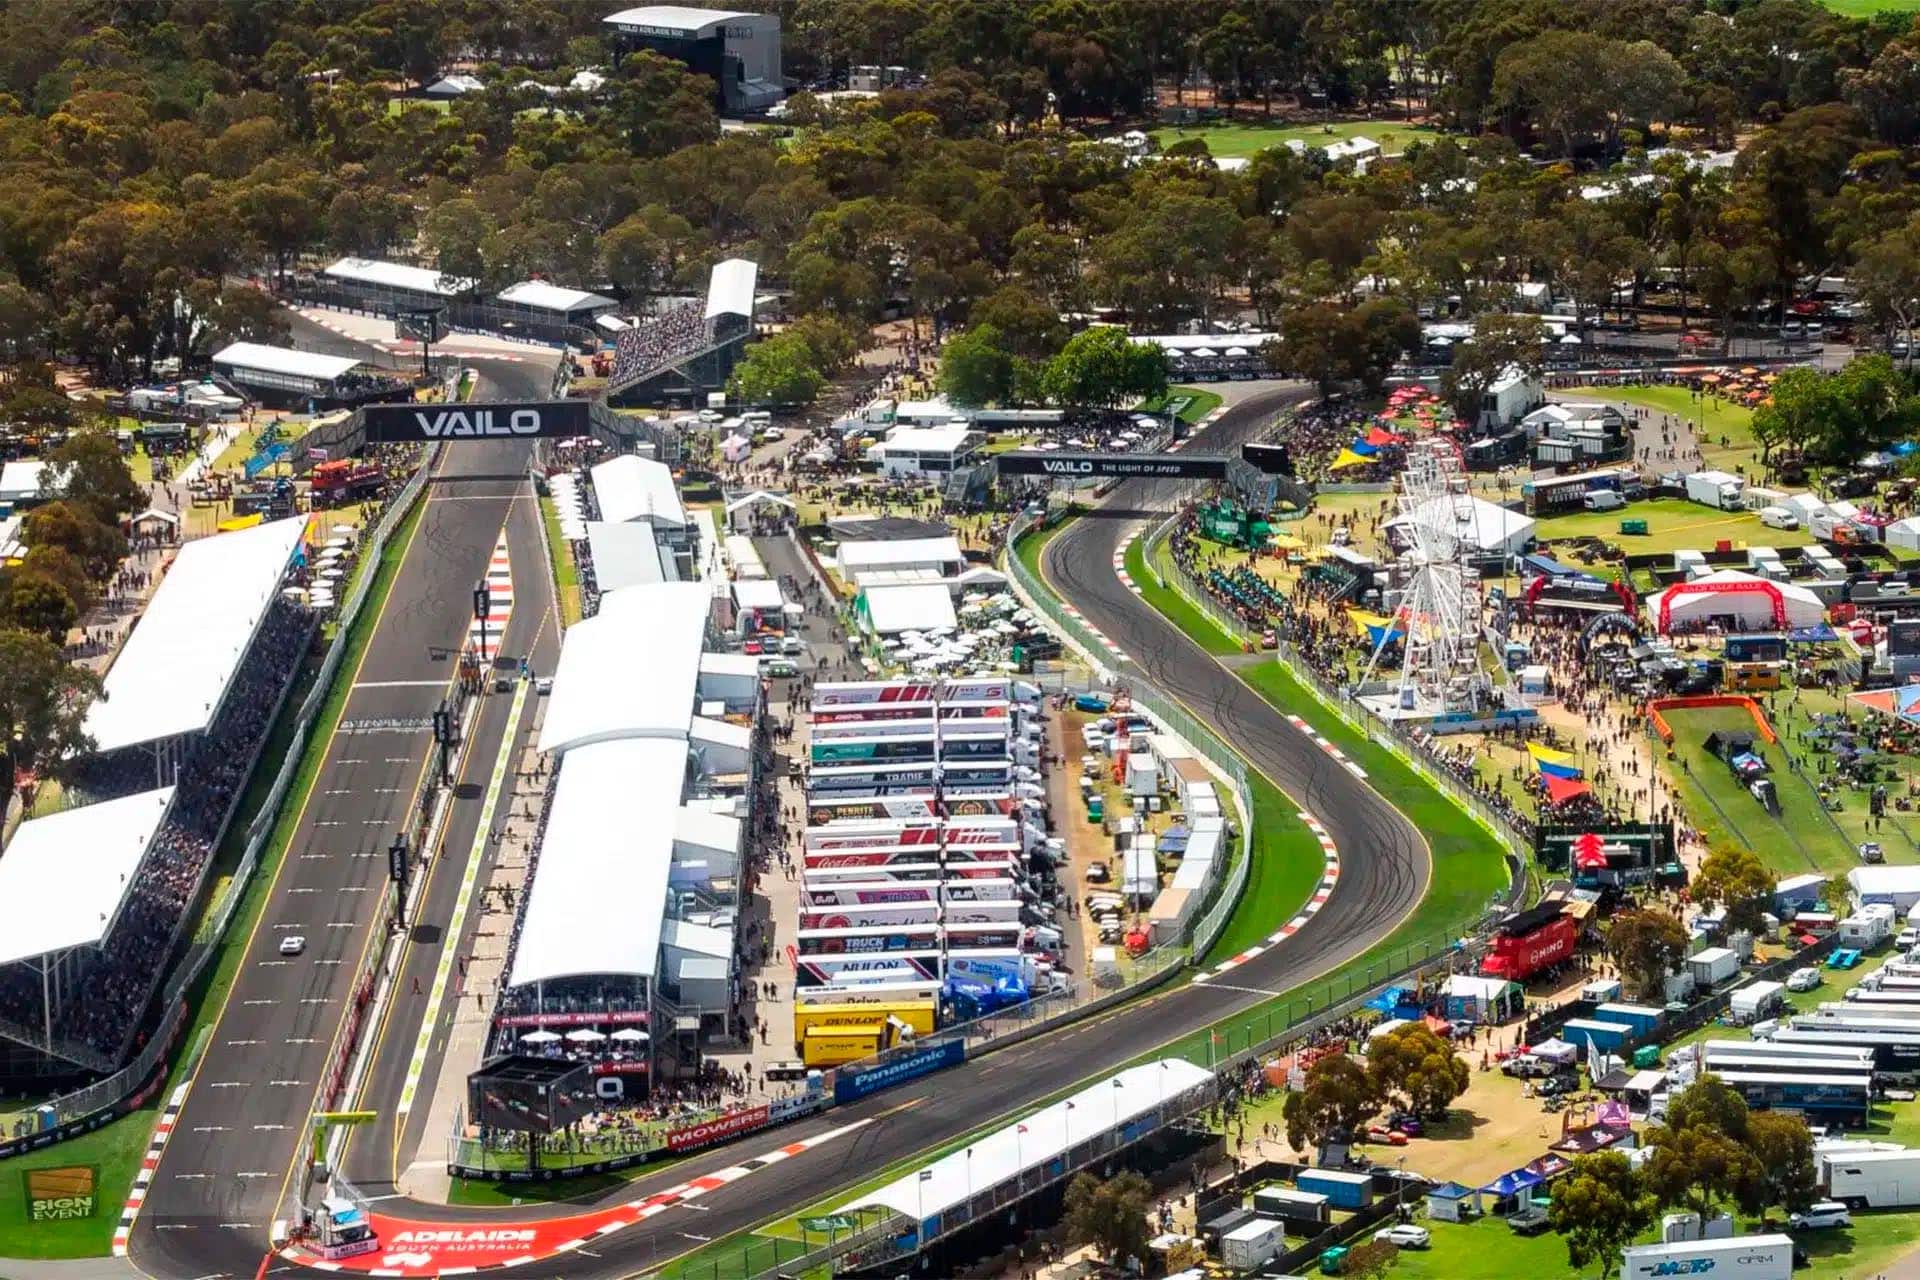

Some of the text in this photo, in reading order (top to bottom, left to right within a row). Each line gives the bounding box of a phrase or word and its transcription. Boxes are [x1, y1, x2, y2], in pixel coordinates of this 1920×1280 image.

[415, 410, 541, 436] VAILO
[1043, 461, 1181, 473] VAILO THE LIGHT OF SPEED
[886, 772, 924, 782] TRADIE
[836, 806, 874, 816] PENRITE
[845, 937, 884, 947] TRUCK
[1539, 939, 1564, 958] HINO
[824, 1017, 883, 1026] DUNLOP
[855, 1049, 946, 1086] Panasonic
[671, 1094, 818, 1144] MOWERS PLUS
[32, 1196, 93, 1211] SIGN
[33, 1206, 91, 1220] EVENT
[392, 1229, 536, 1242] ADELAIDE
[386, 1243, 531, 1252] SOUTH AUSTRALIA
